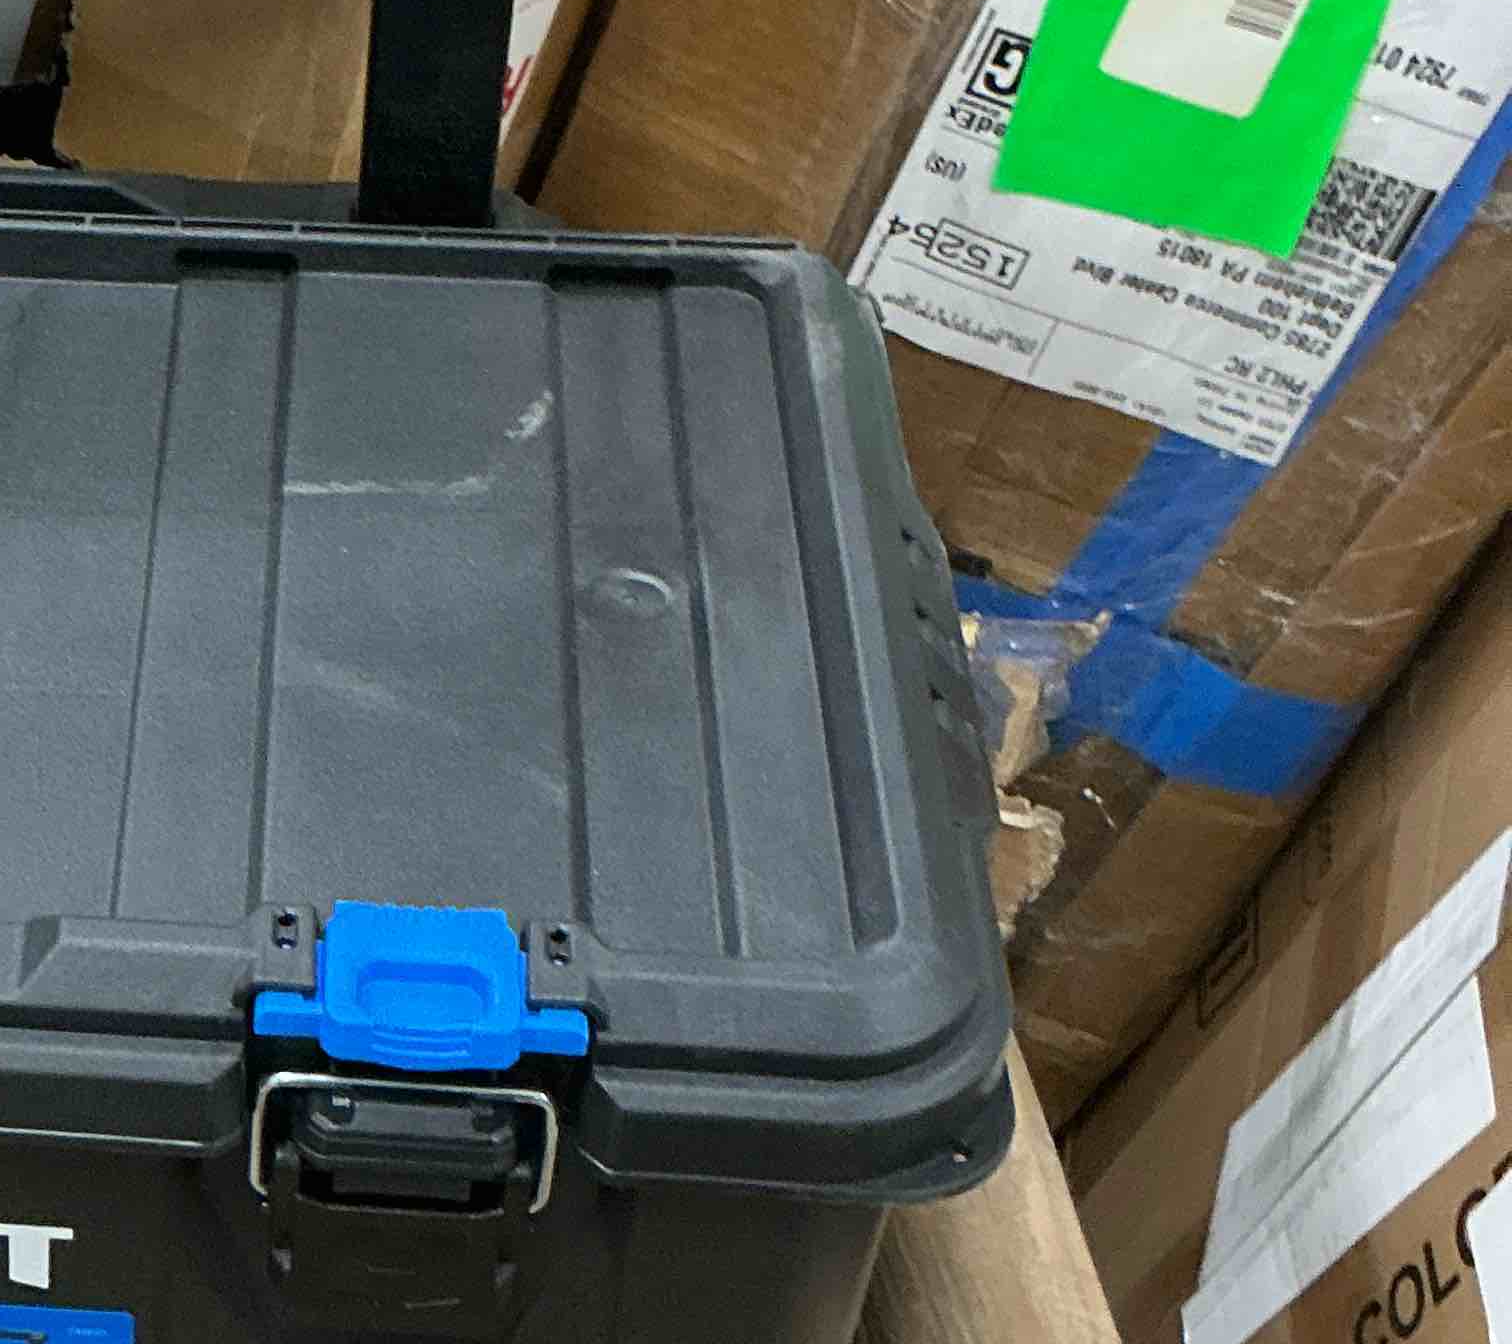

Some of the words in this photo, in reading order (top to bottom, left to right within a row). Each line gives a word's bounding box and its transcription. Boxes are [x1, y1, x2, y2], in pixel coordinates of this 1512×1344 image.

[945, 105, 1007, 138] edEx
[887, 215, 1015, 278] 15254
[1220, 260, 1251, 283] PA
